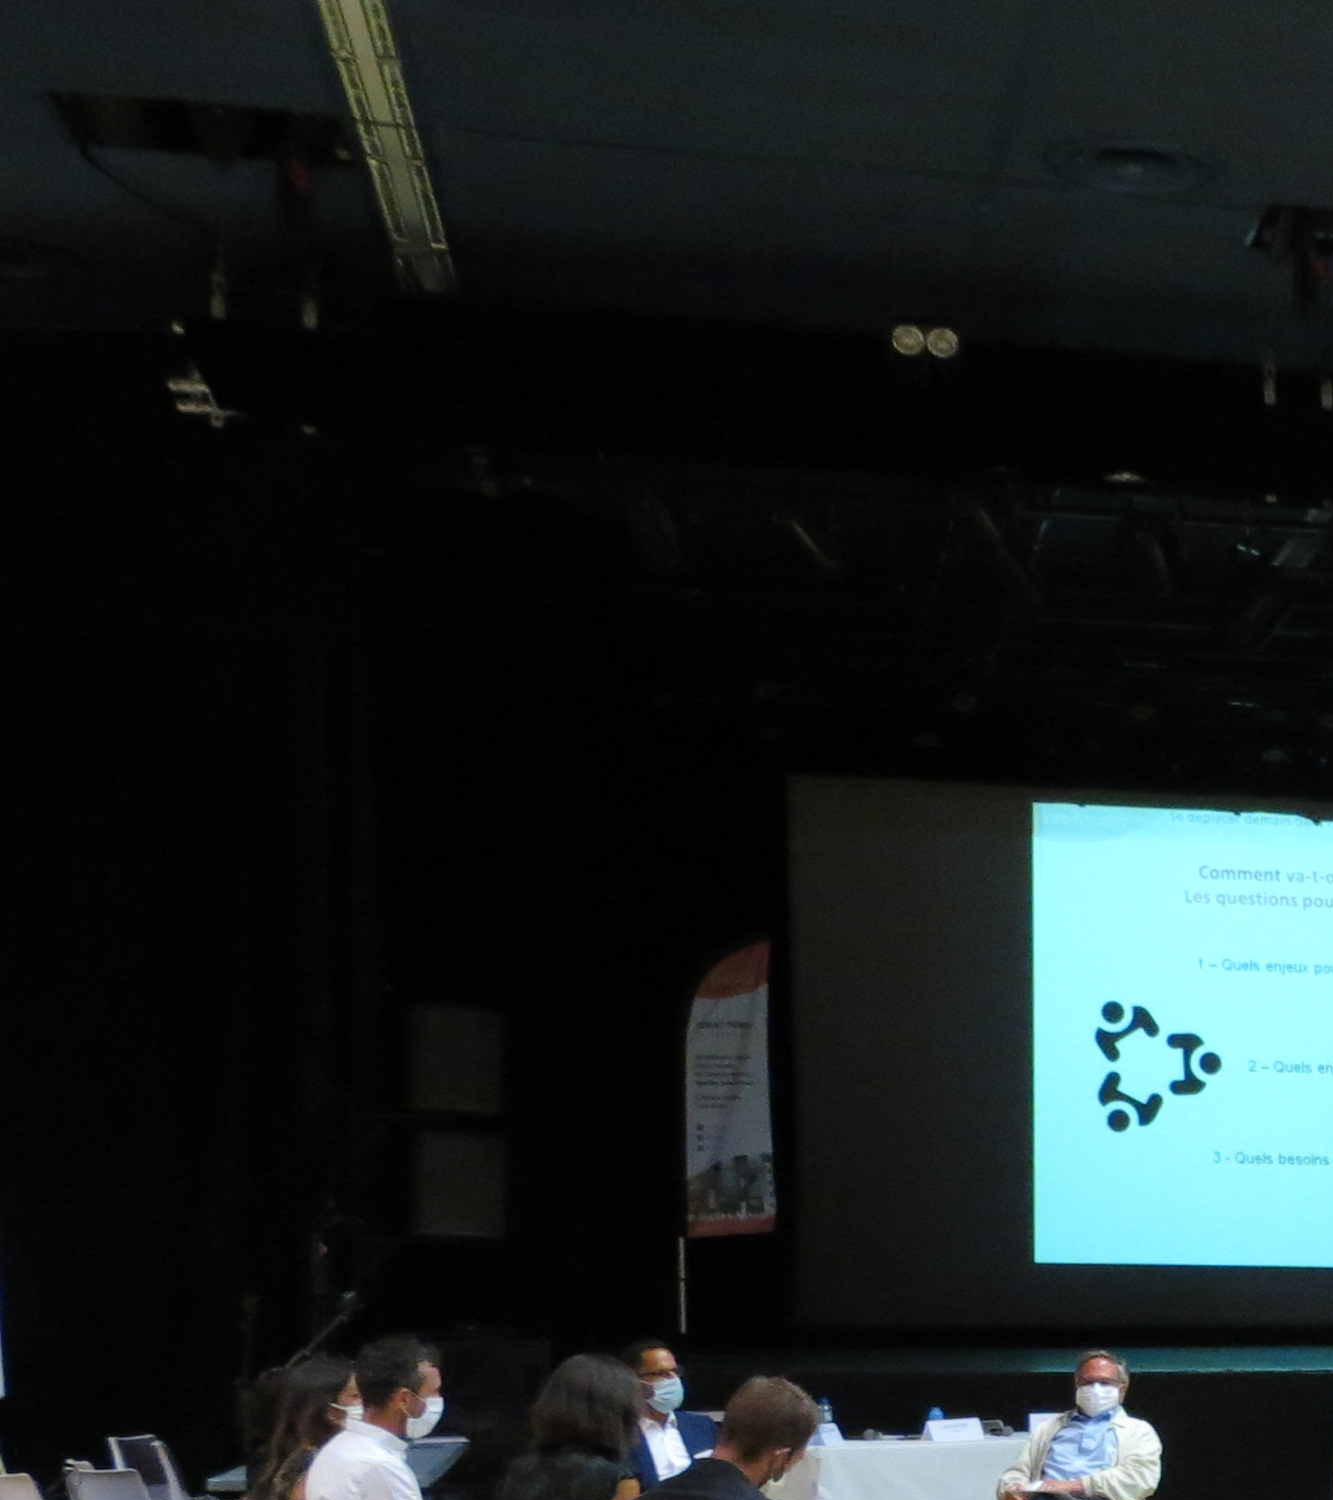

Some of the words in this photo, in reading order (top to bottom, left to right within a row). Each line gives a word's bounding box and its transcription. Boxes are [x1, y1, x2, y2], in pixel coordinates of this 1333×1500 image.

[1199, 865, 1281, 882] Comment
[1184, 889, 1211, 904] Les
[1216, 891, 1298, 907] questions
[1221, 958, 1261, 972] Quels
[1265, 960, 1309, 975] enjeux
[1273, 1060, 1312, 1074] Quels
[1234, 1151, 1274, 1165] Quels
[1278, 1152, 1330, 1167] besoins
